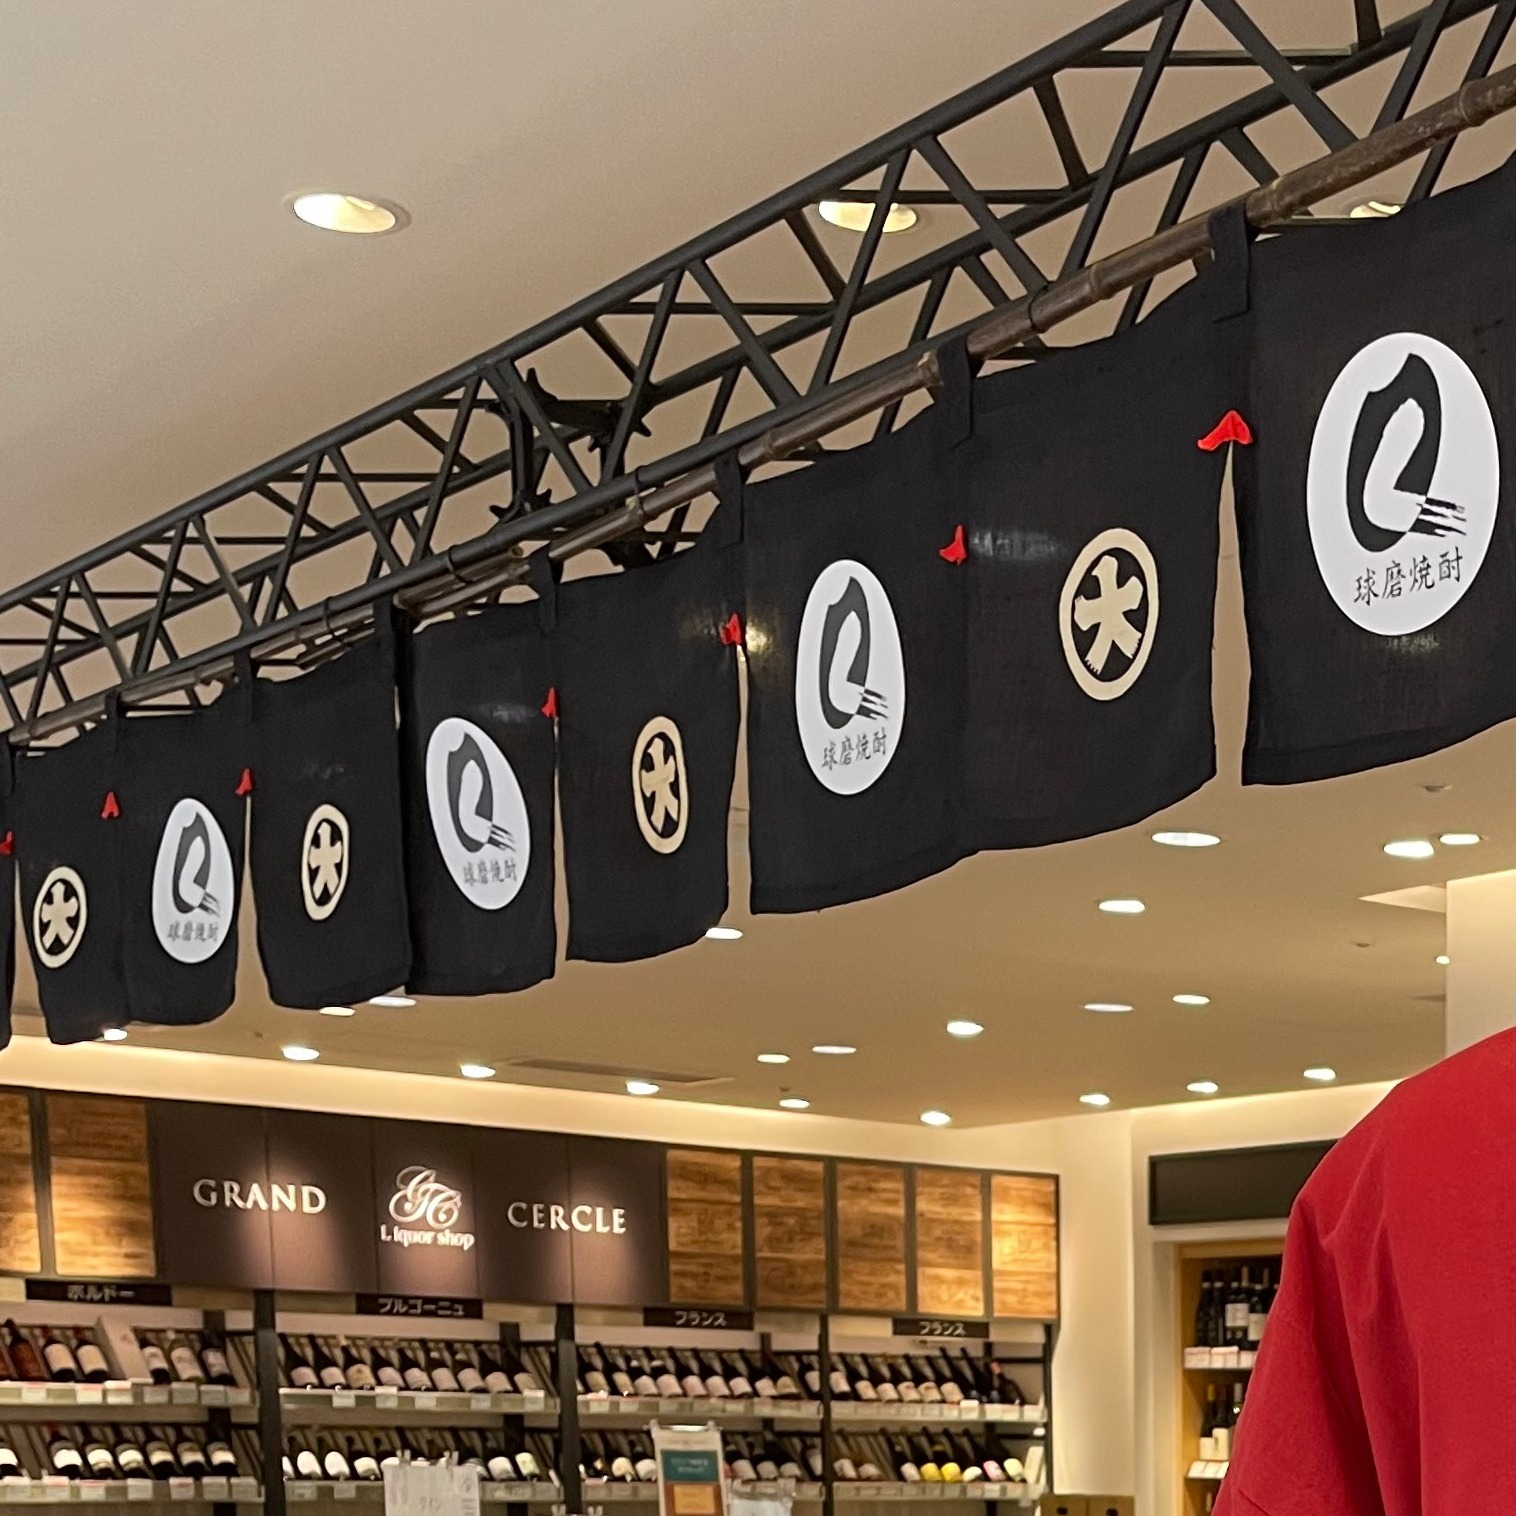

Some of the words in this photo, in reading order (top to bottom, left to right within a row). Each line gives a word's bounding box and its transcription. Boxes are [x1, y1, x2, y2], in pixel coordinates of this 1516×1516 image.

[1353, 546, 1463, 606] 球磨焼酎
[821, 727, 887, 770] 球磨焼酎
[193, 1179, 327, 1214] GRAND
[507, 1202, 626, 1234] CERCLE
[67, 1284, 136, 1302] ボルドー
[674, 1310, 728, 1327] フランス
